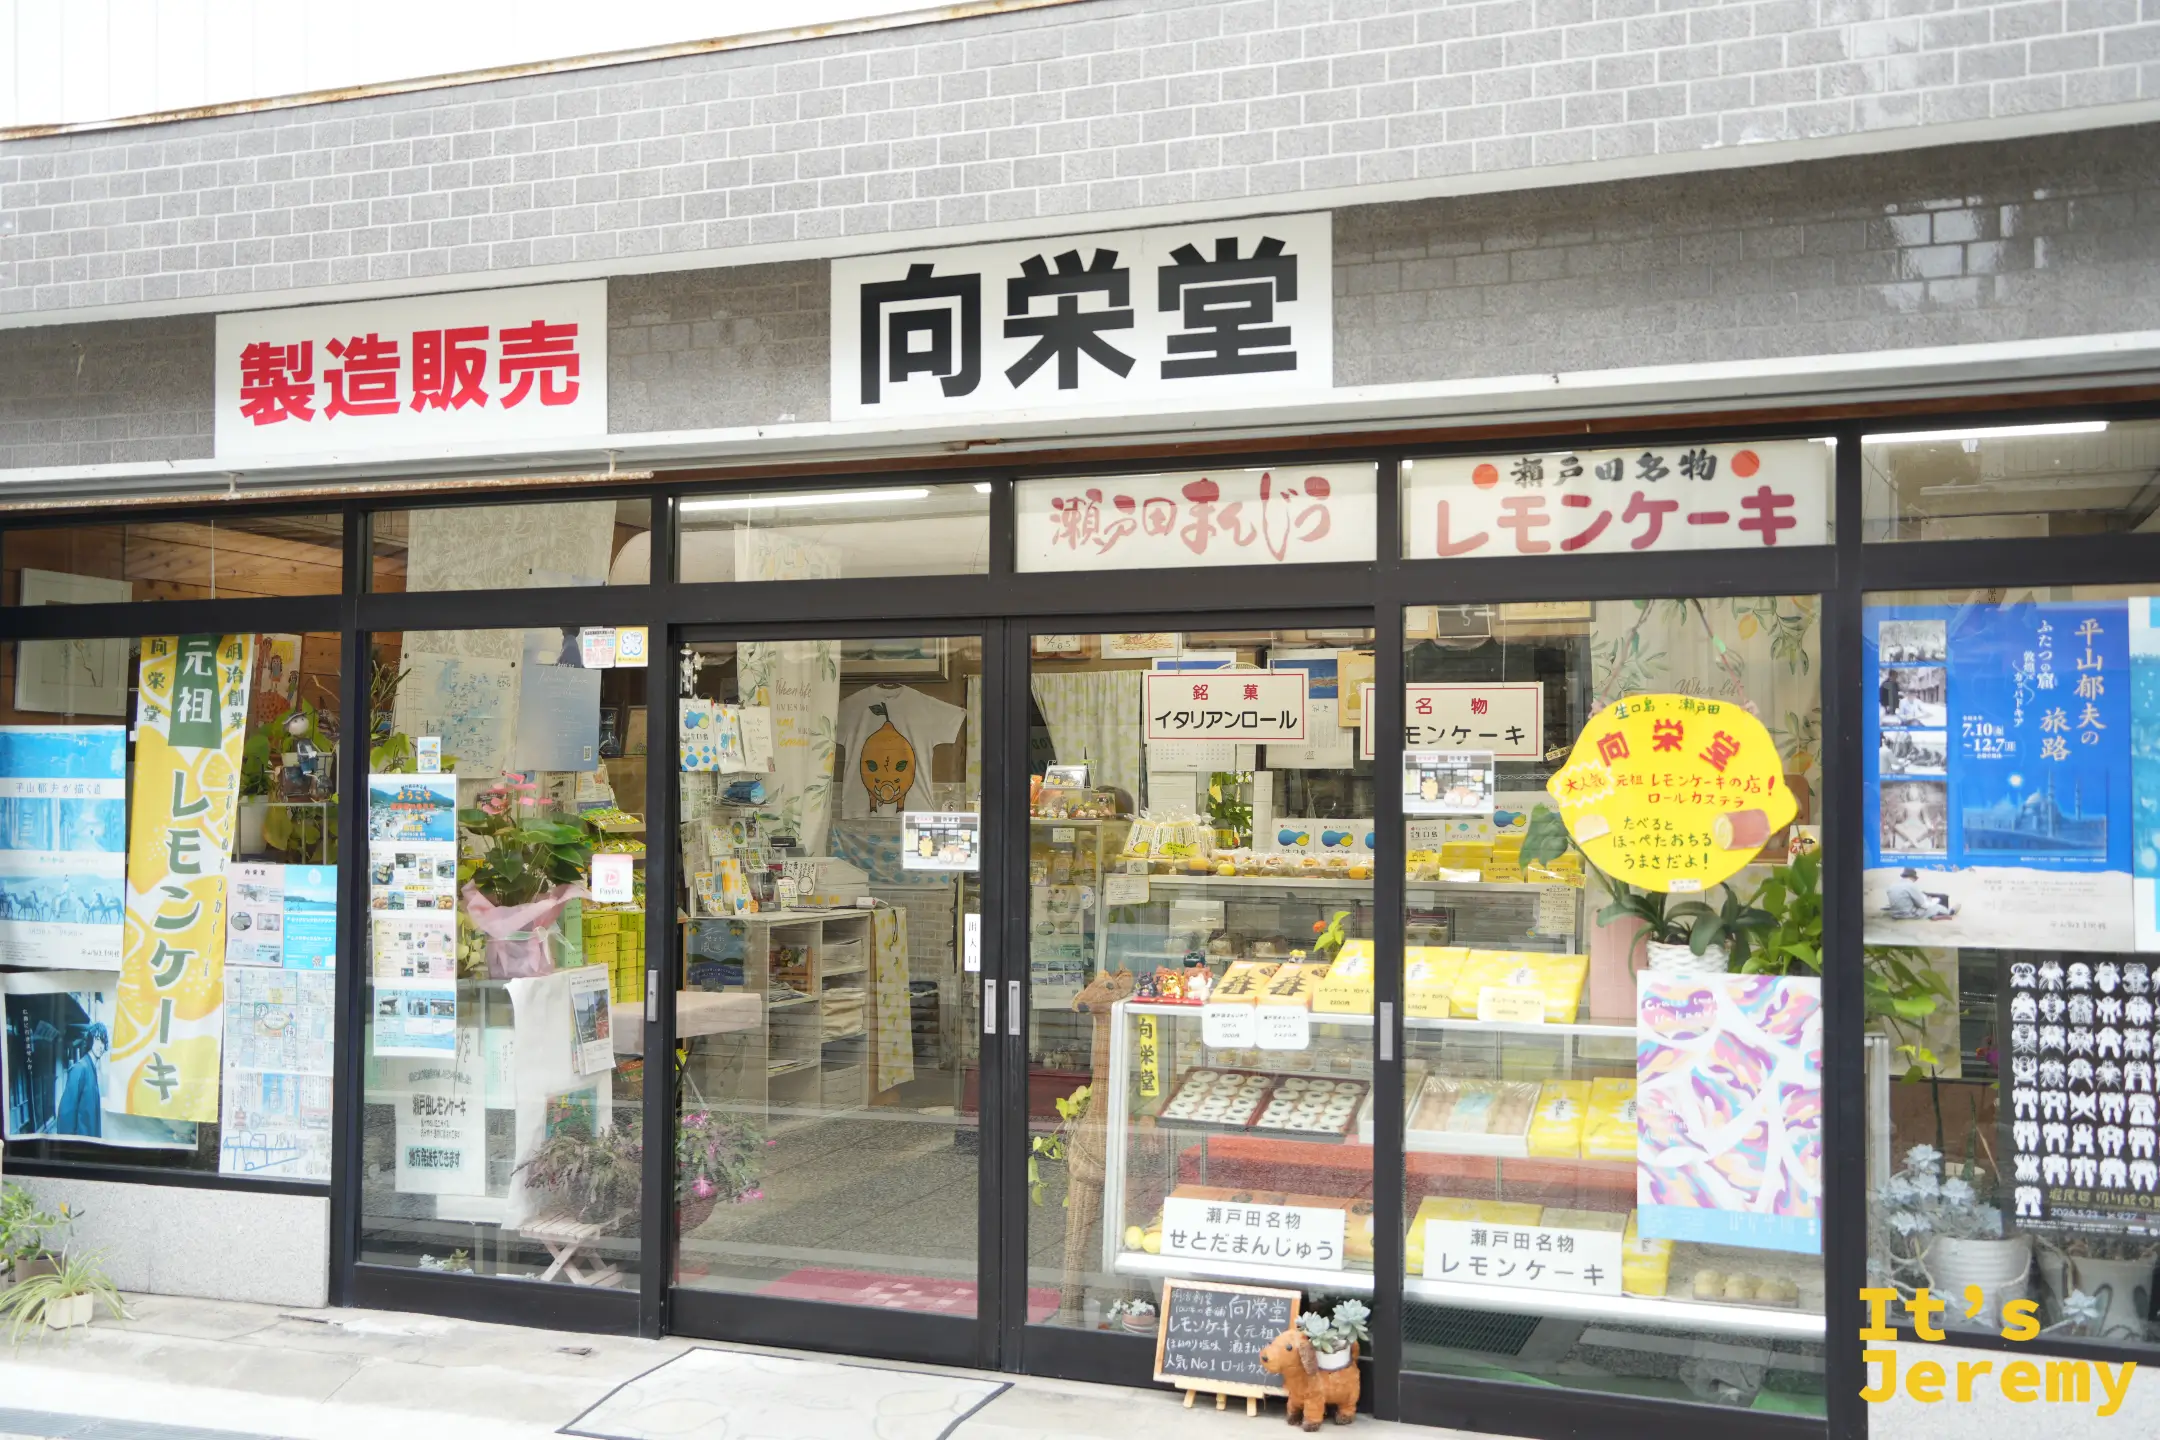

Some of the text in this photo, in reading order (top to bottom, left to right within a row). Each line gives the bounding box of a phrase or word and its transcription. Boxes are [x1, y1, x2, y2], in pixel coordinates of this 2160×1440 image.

[860, 235, 1299, 405] 向栄堂
[239, 320, 581, 427] 製造販売
[1511, 448, 1717, 488] 瀬戸田名物
[1436, 485, 1797, 559] レモンケーキ
[144, 637, 168, 723] 向栄堂
[177, 640, 213, 724] 元祖
[226, 642, 244, 730] 明治創業
[1192, 684, 1259, 701] 銘菓
[1674, 677, 1714, 697] When
[2074, 617, 2106, 746] 平山郁夫の
[1154, 709, 1298, 730] イタリアンロール
[1415, 697, 1489, 716] 名物
[1614, 697, 1720, 720] 生口島・瀬戸田
[1405, 724, 1526, 747] モンケーキ
[1597, 718, 1741, 773] 向栄堂
[2039, 707, 2072, 763] 旅路
[1565, 773, 1606, 794] 大人気
[1616, 774, 1644, 787] 元祖
[1648, 793, 1746, 808] ロールカステラ
[1623, 815, 1674, 831] たべると
[1613, 832, 1713, 848] ほっぺたおちる
[146, 771, 209, 1101] レモンケーキ
[1137, 1017, 1156, 1093] 向栄堂
[412, 1092, 467, 1117] 瀬戸田レモンケーキ
[1206, 1207, 1302, 1230] 瀬戸田名物
[1169, 1229, 1334, 1261] せとだまんじゅう
[1470, 1228, 1575, 1254] 瀬戸田名物
[1440, 1251, 1605, 1287] レモンケーキ
[1229, 1294, 1287, 1323] 向栄堂
[1169, 1315, 1231, 1338] レモンケーキ
